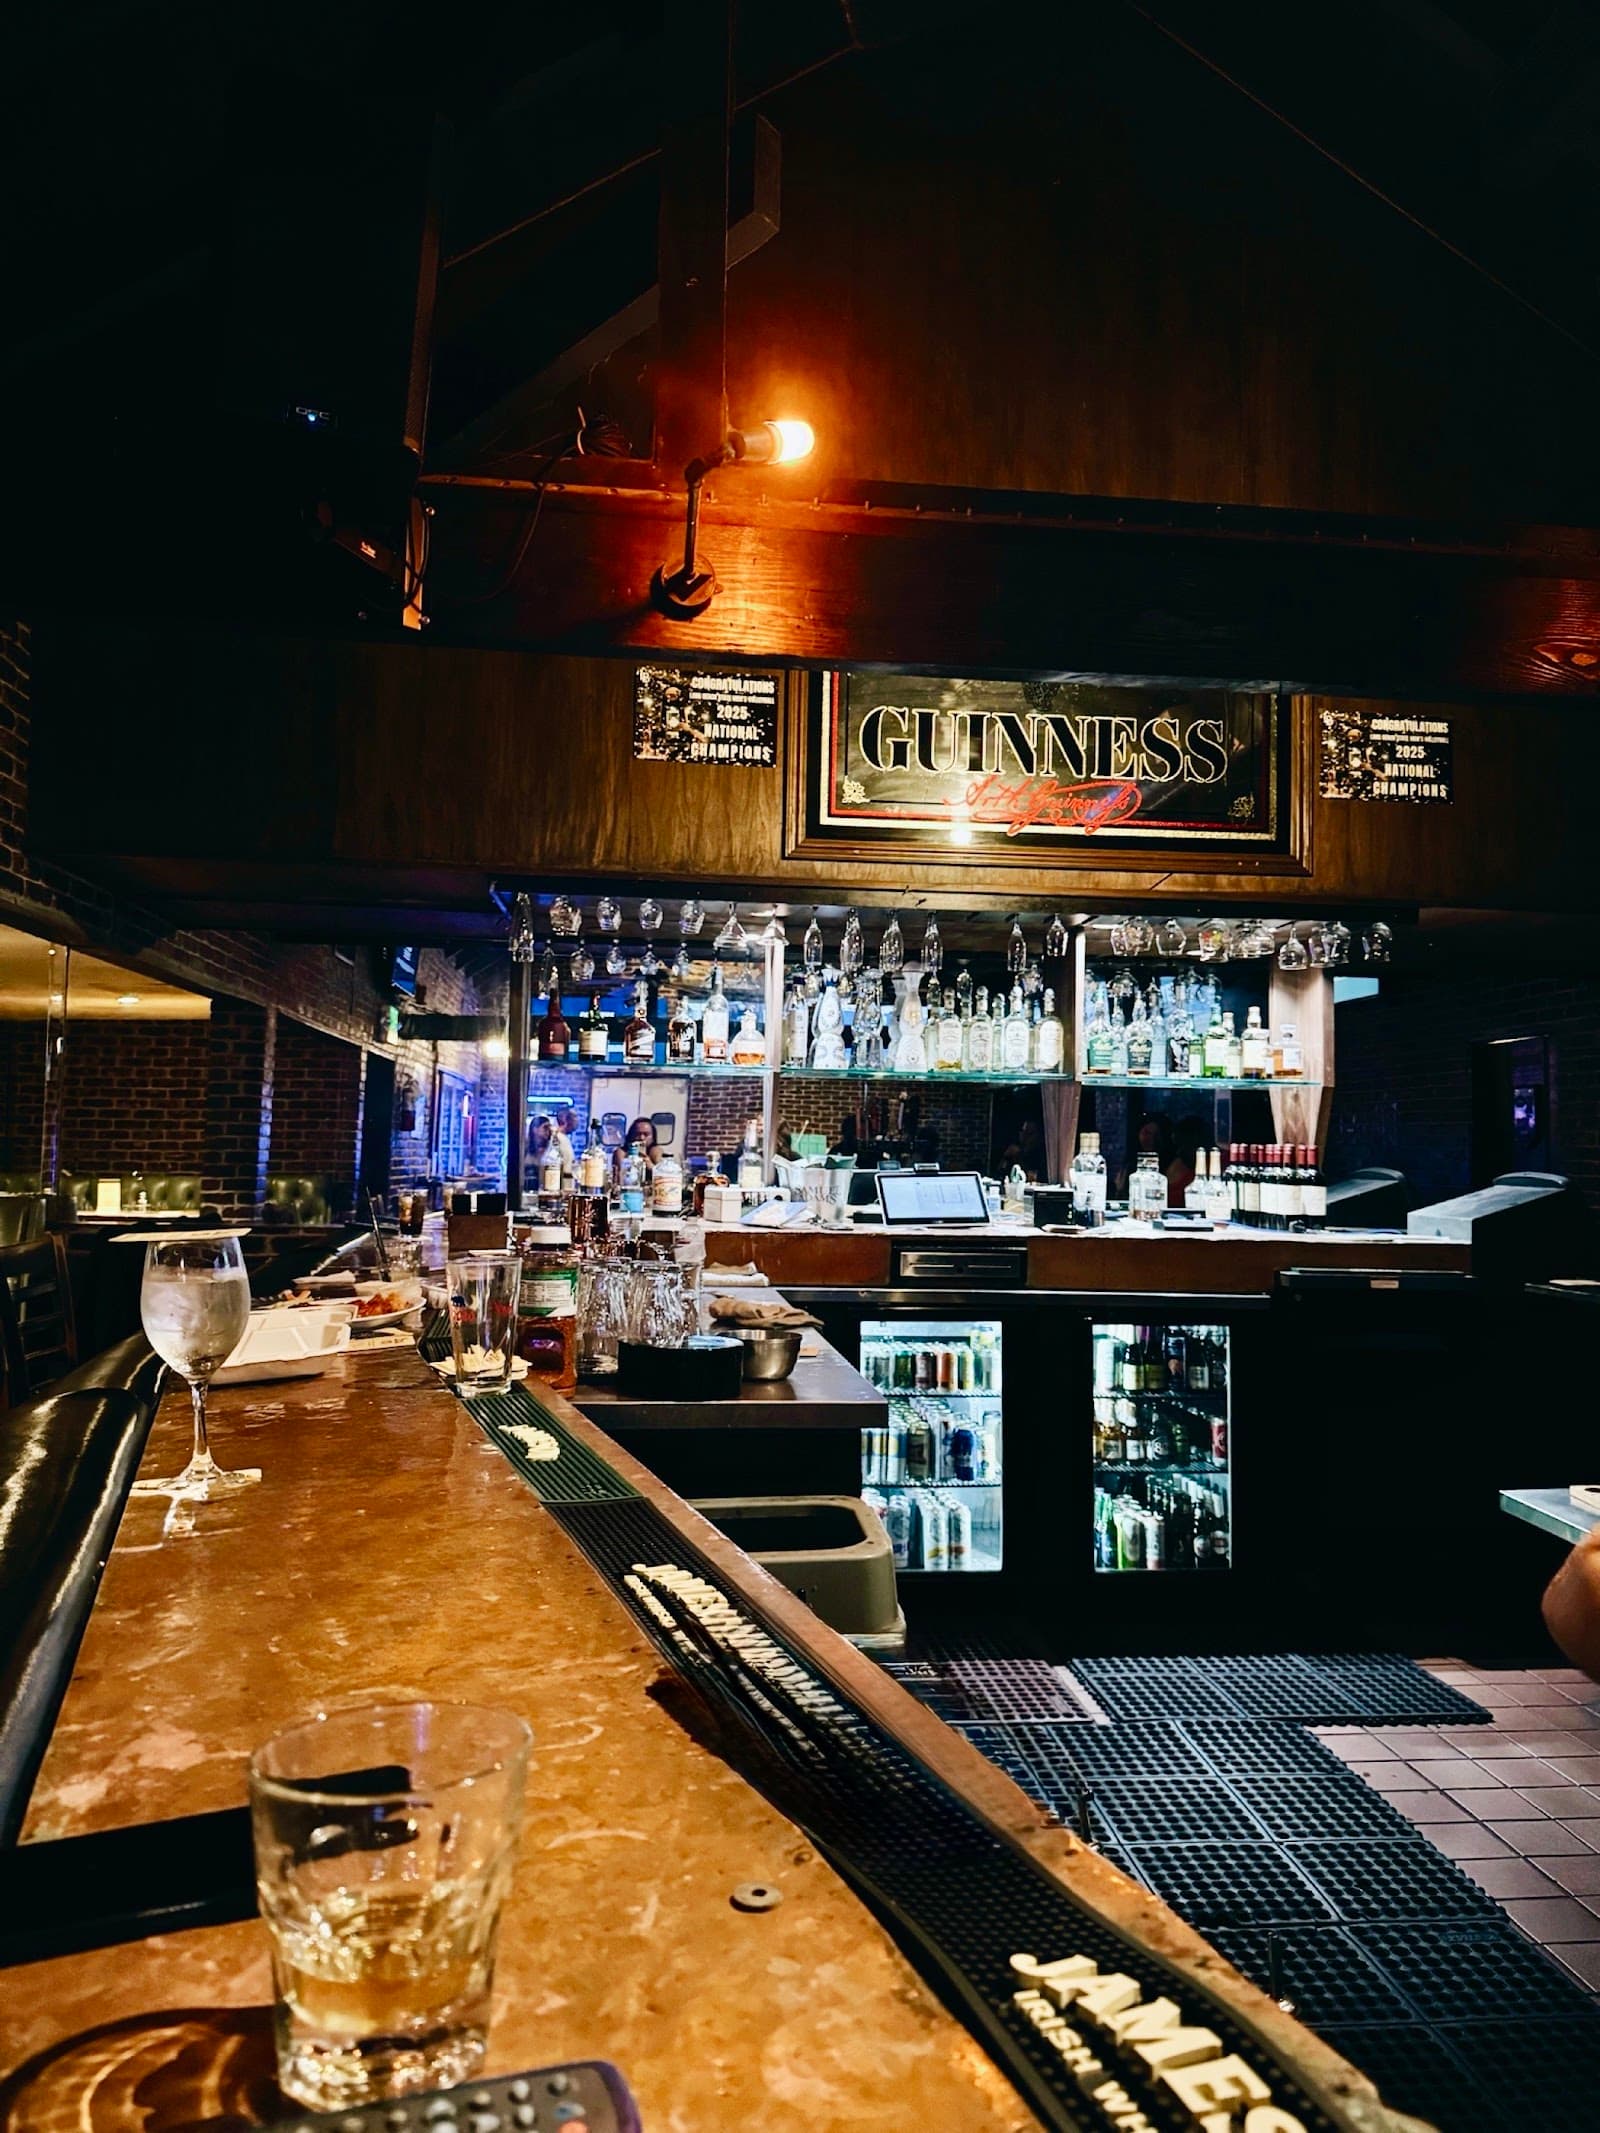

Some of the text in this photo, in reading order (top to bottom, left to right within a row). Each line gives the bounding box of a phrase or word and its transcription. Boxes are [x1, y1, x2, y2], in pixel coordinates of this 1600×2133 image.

[690, 676, 775, 694] CONGRATULATIONS
[716, 704, 750, 720] 2025
[703, 722, 759, 741] NATIONAL
[1371, 718, 1449, 734] CONGRATULATIONS
[690, 743, 772, 761] CHAMPIONS
[859, 705, 1228, 784] GUINNESS
[1395, 745, 1425, 759] 2025
[1384, 762, 1436, 778] NATIONAL
[1372, 781, 1448, 799] CHAMPIONS
[1013, 1989, 1102, 2077] IRISH
